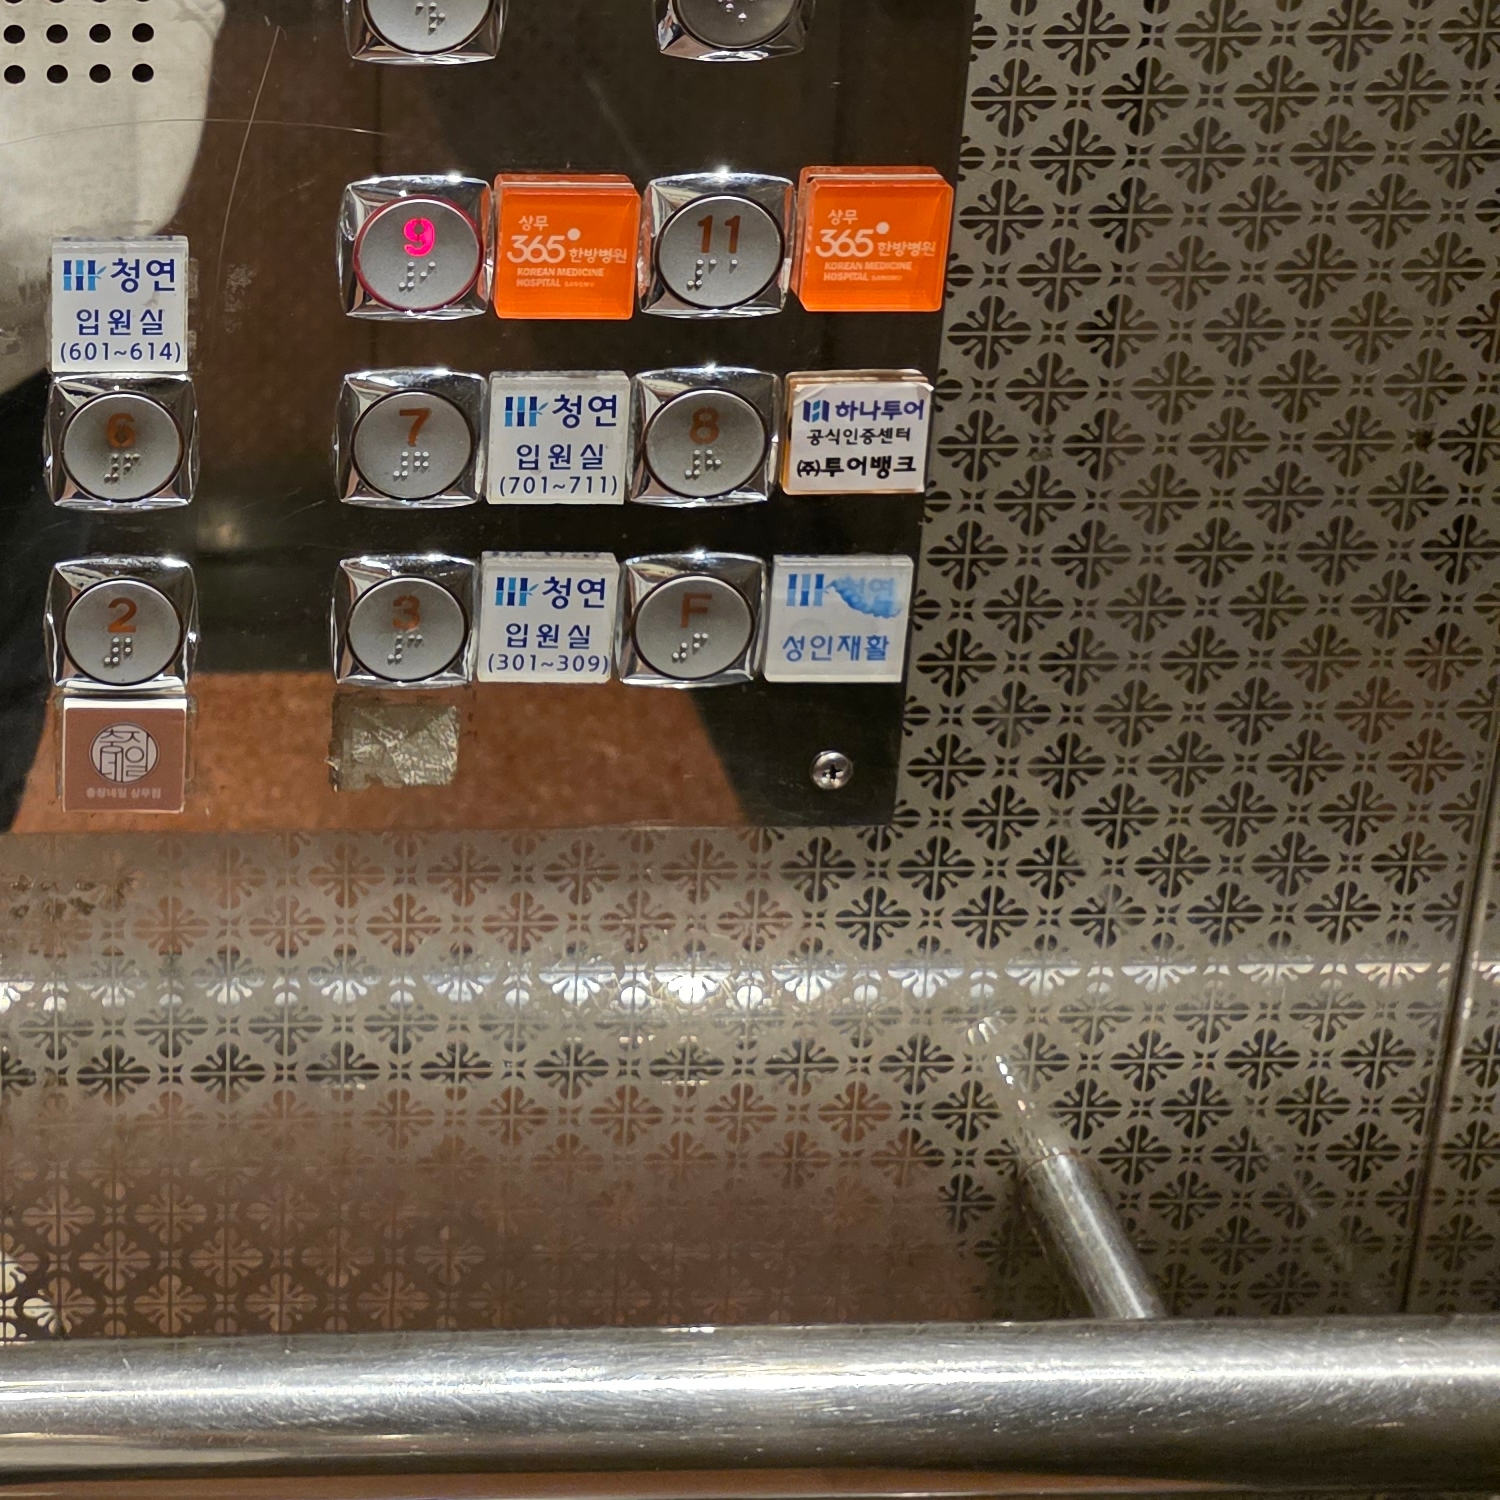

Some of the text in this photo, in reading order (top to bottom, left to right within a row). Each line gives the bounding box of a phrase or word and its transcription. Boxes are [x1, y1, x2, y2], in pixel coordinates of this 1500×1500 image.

[518, 215, 549, 231] 상무
[828, 209, 859, 226] 상무
[403, 216, 435, 257] 9
[697, 214, 741, 254] 11
[568, 247, 627, 264] 한방병원
[877, 241, 936, 257] 한방병원
[111, 257, 176, 293] 청연
[517, 267, 604, 277] KOREAN MEDICINE
[823, 272, 869, 281] HOSPITAL
[824, 261, 912, 270] KOREAN MEDICINE
[516, 278, 561, 287] HOSPITAL
[60, 342, 181, 363] (601~614)
[552, 394, 618, 429] 청연
[835, 399, 925, 421] 하나투어
[107, 412, 136, 448] 6
[398, 407, 431, 447] 7
[689, 407, 720, 445] 8
[806, 427, 911, 446] 공식인증센터
[499, 475, 618, 496] (701~711)
[542, 576, 606, 609] 청연
[107, 597, 138, 633] 2
[392, 595, 421, 631] 3
[680, 592, 713, 628] F
[782, 634, 890, 662] 성인재활
[488, 653, 609, 675] (301~309)
